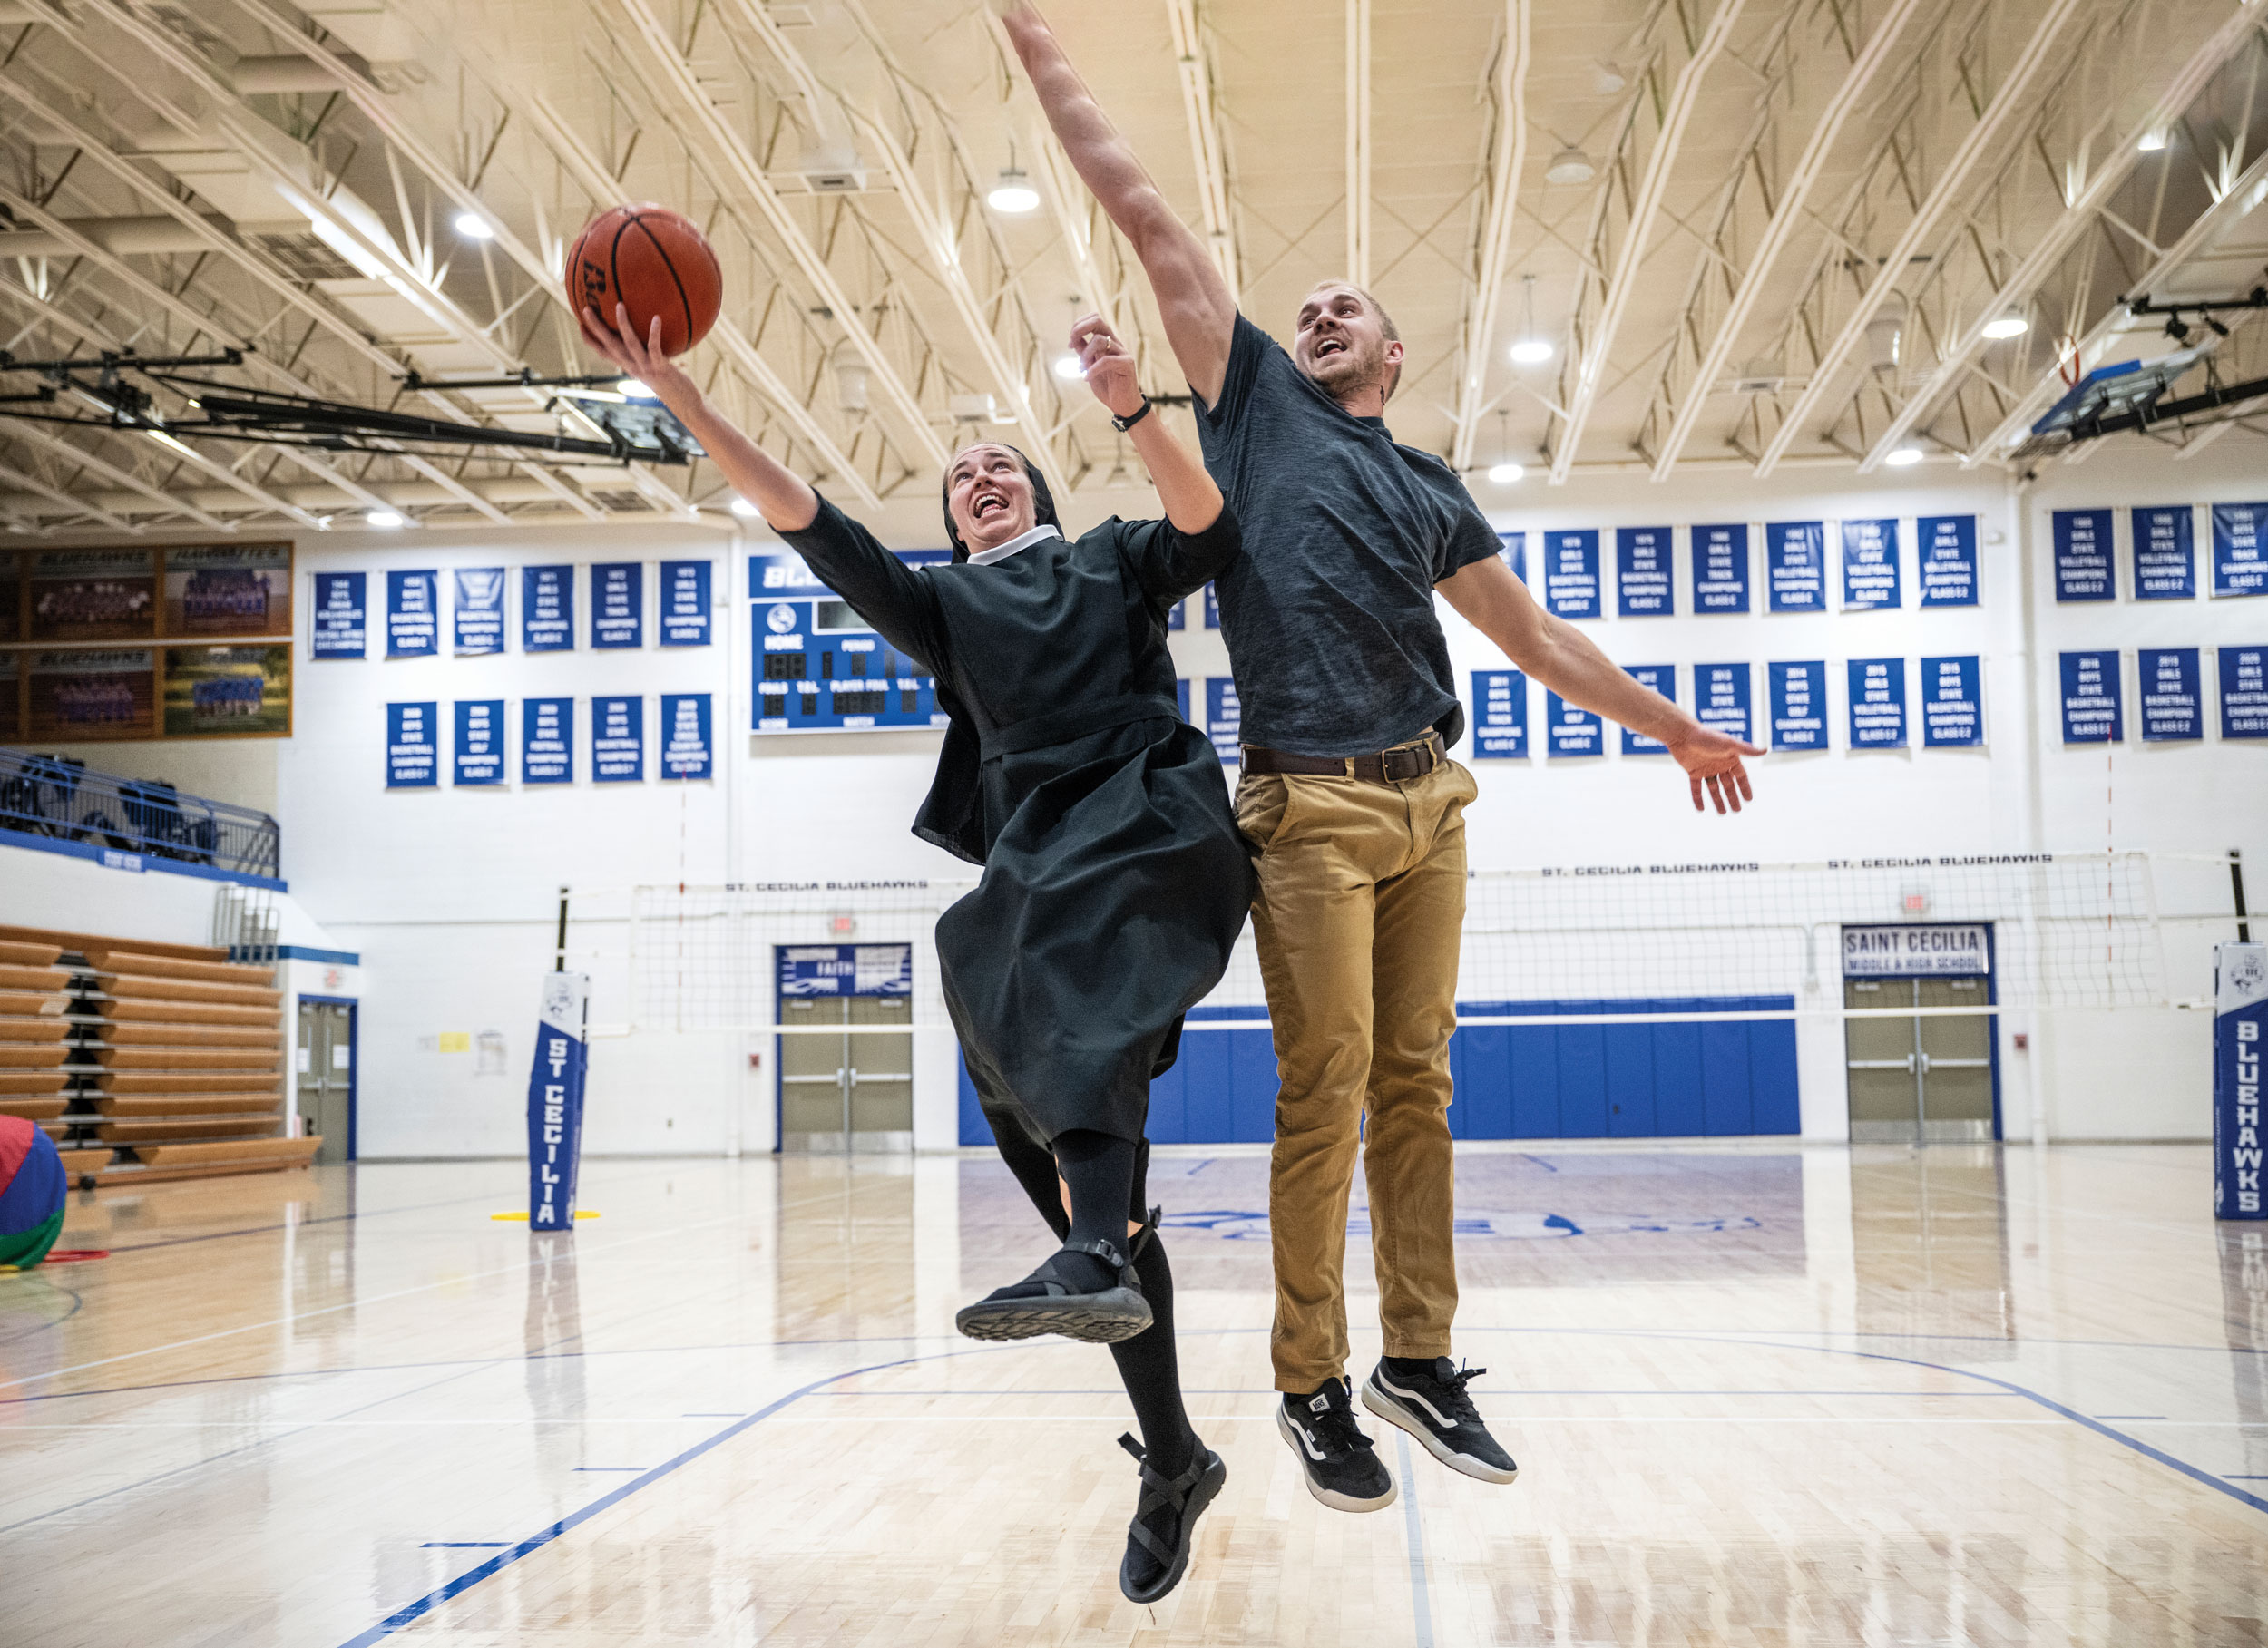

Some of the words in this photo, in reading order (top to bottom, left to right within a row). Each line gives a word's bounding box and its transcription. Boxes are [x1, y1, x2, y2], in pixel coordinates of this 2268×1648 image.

[2226, 693, 2268, 704] BASKETBA
[2068, 710, 2115, 721] CHAMPIONS
[2147, 707, 2194, 718] CHAMPIONS
[1828, 860, 1854, 870] ST.
[1862, 858, 1931, 869] CECILIA
[1939, 854, 2053, 866] BLUEHAWKS
[1542, 867, 1568, 877] ST.
[1575, 866, 1643, 876] CECILIA
[1649, 863, 1760, 874] BLUEHAWKS
[725, 883, 749, 892] ST.
[757, 883, 820, 892] CECILIA
[826, 881, 929, 891] BLUEHAWKS
[1846, 931, 1901, 953] SAINT
[1907, 931, 1980, 952] CECILIA
[816, 961, 855, 977] FAITH
[2233, 1020, 2263, 1213] BLUEHAWKS
[537, 1085, 565, 1224] CECILIA
[1312, 1398, 1326, 1409] VANS
